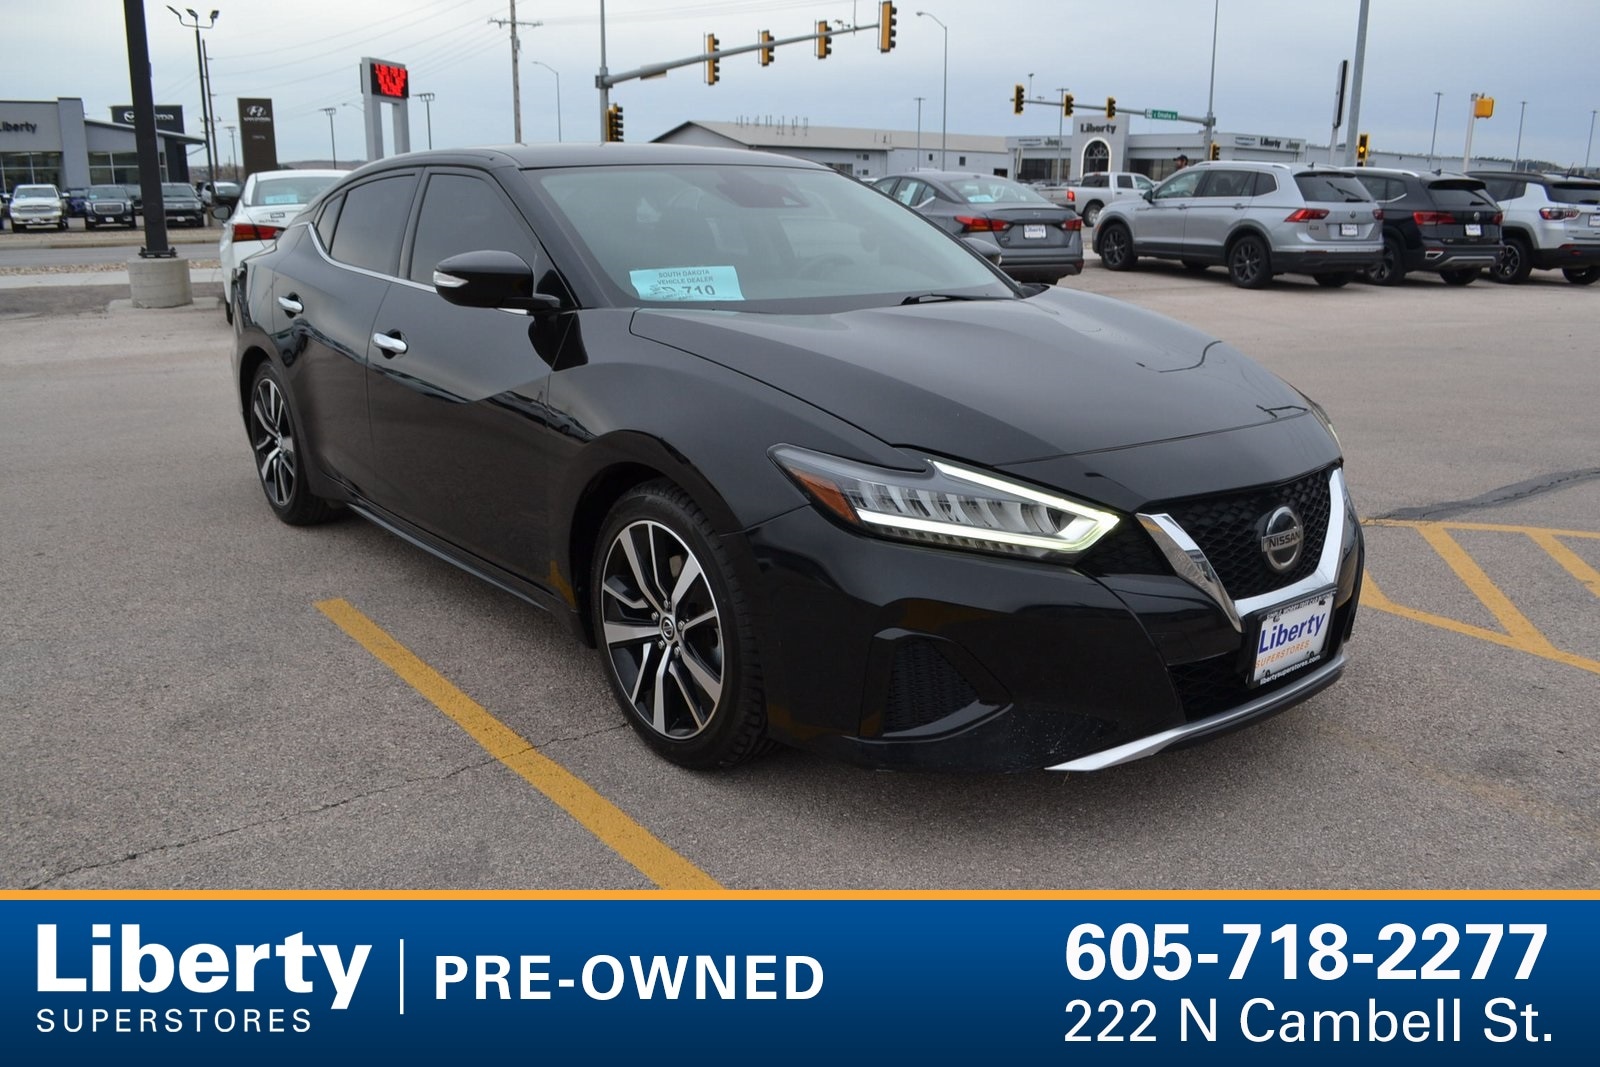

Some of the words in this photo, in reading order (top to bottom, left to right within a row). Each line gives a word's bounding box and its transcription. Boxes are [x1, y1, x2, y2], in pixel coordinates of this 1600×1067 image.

[1080, 122, 1117, 135] Liberty
[686, 275, 714, 283] DEALER
[682, 284, 715, 296] 710
[1268, 530, 1301, 548] NISSAN
[1258, 612, 1325, 654] Liberty
[1255, 639, 1310, 668] SUPERSTORES
[1259, 654, 1321, 686] libertysuperstores.com
